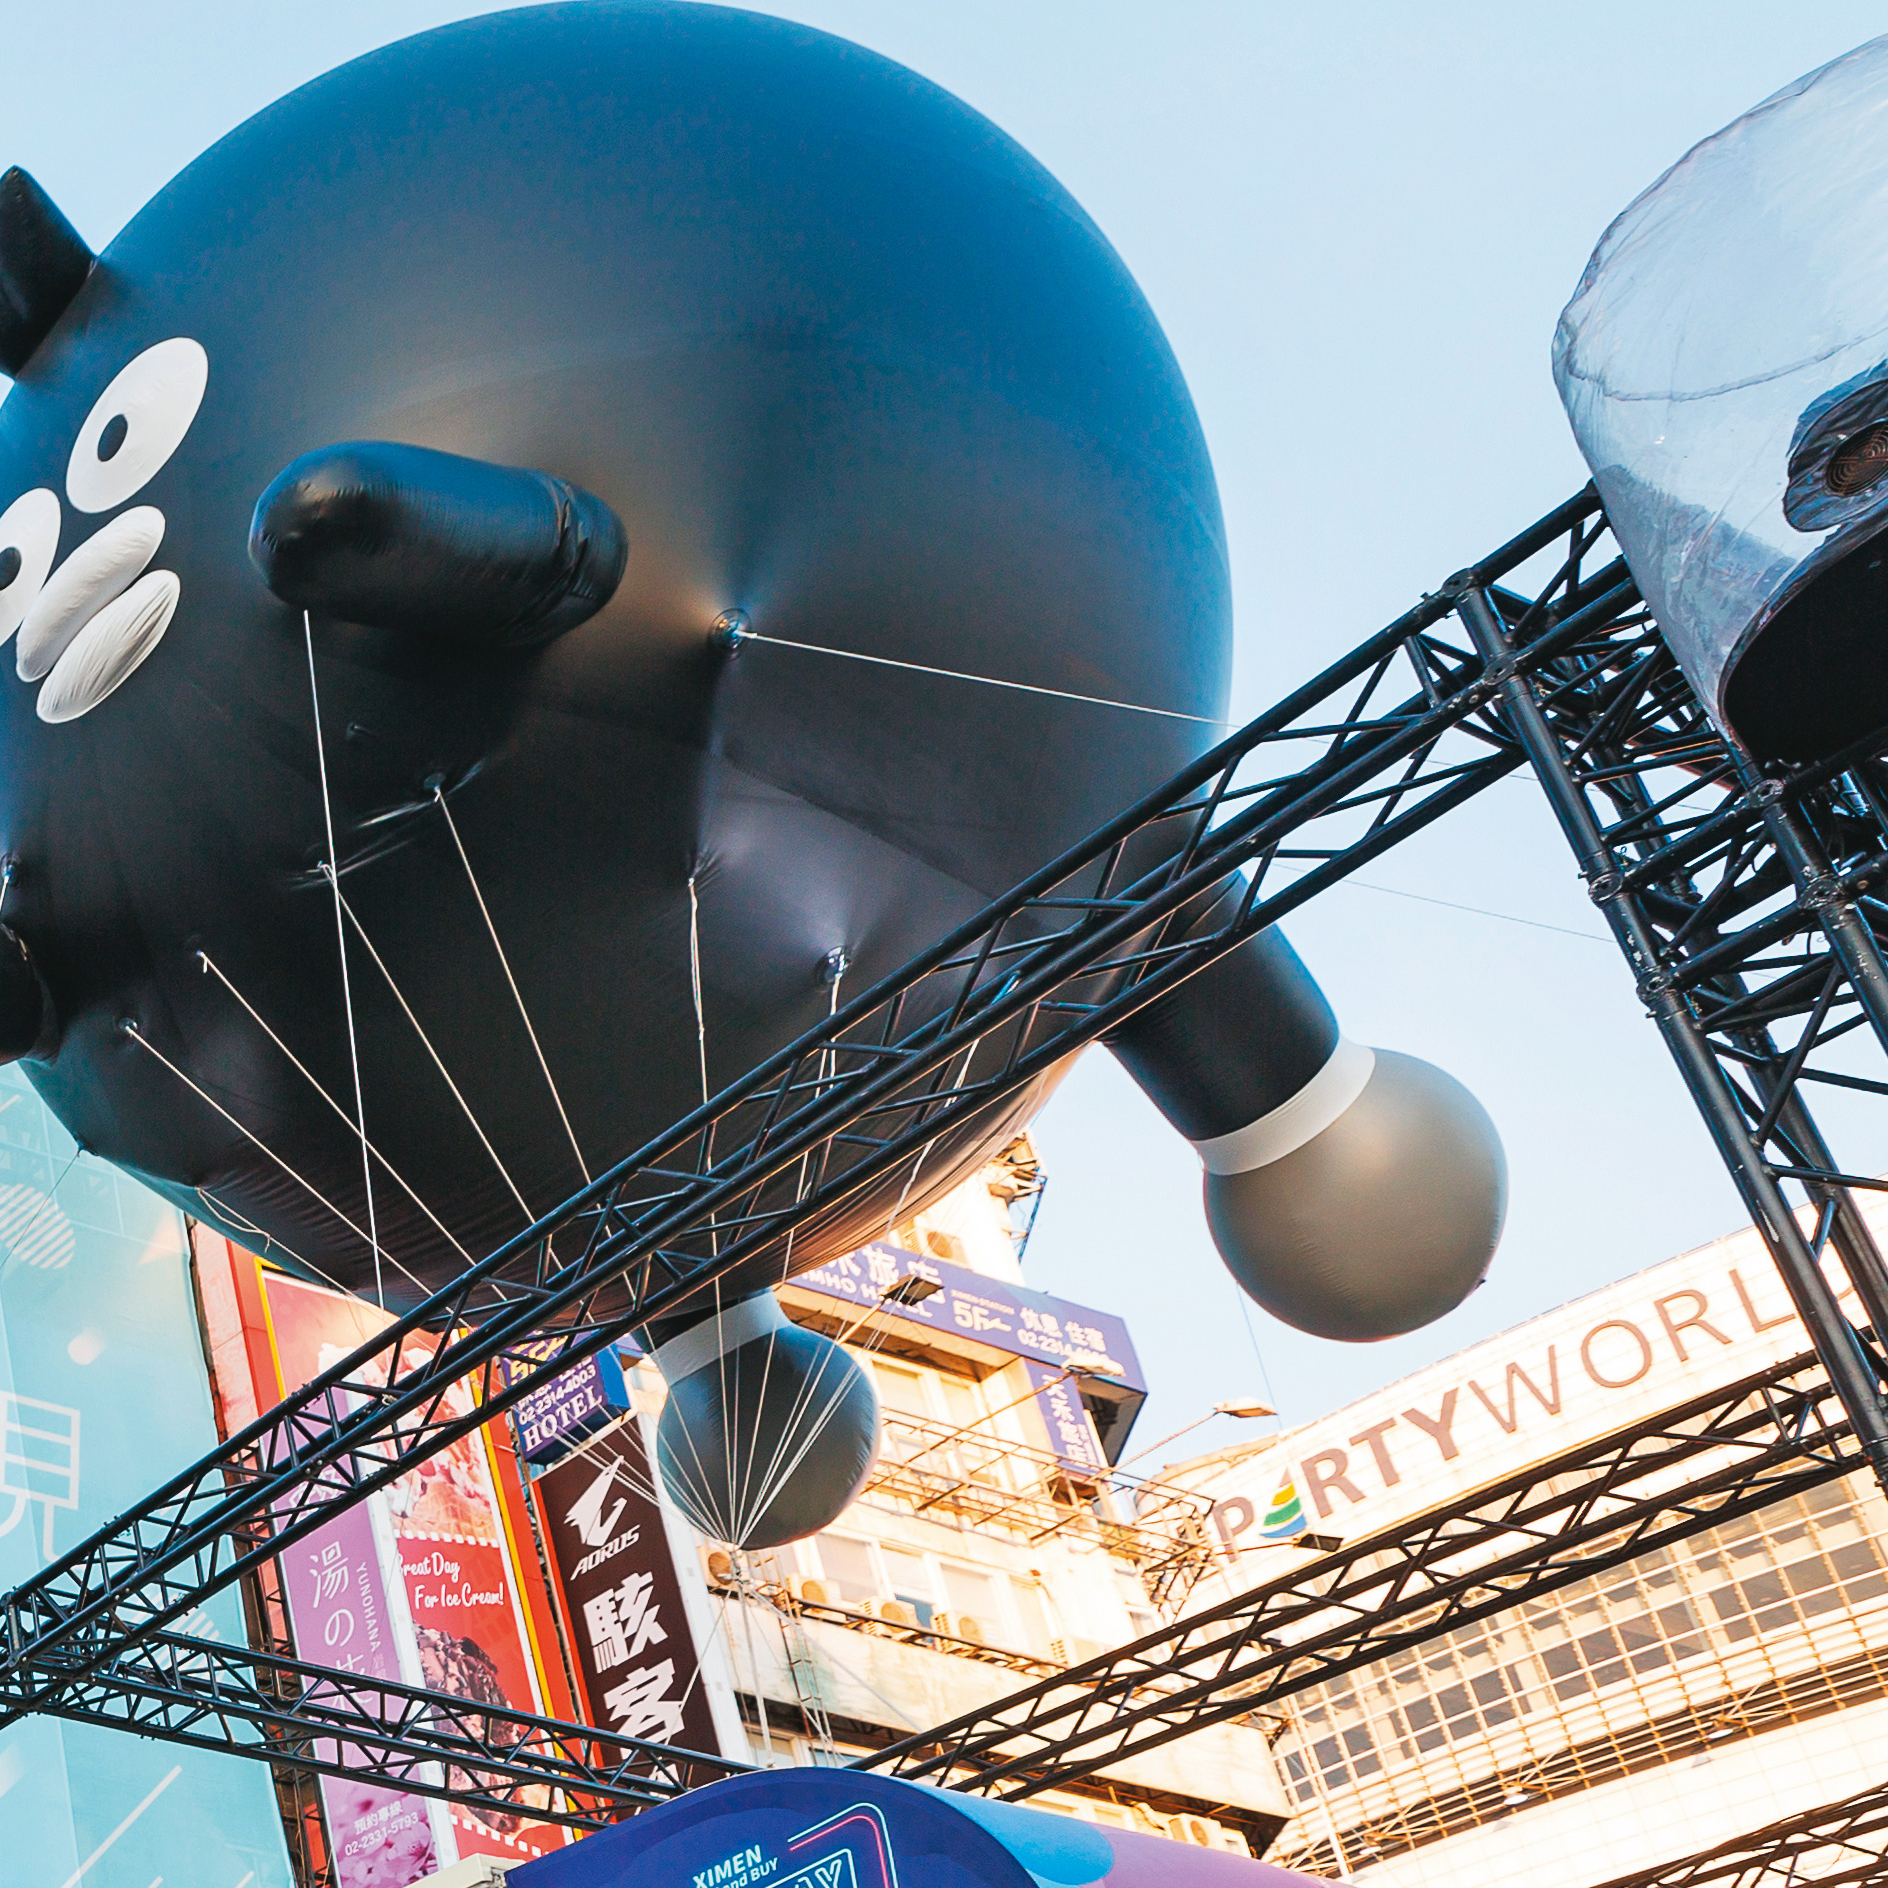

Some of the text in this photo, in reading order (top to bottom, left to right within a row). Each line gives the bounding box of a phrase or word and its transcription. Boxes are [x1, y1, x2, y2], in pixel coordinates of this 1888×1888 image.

[523, 1386, 602, 1452] HOTEL
[432, 1552, 460, 1583] Day
[570, 1525, 641, 1580] AORUS
[357, 1562, 381, 1652] YUNOHANA
[415, 1582, 504, 1609] For Ice Cream!
[751, 1857, 778, 1881] BUY
